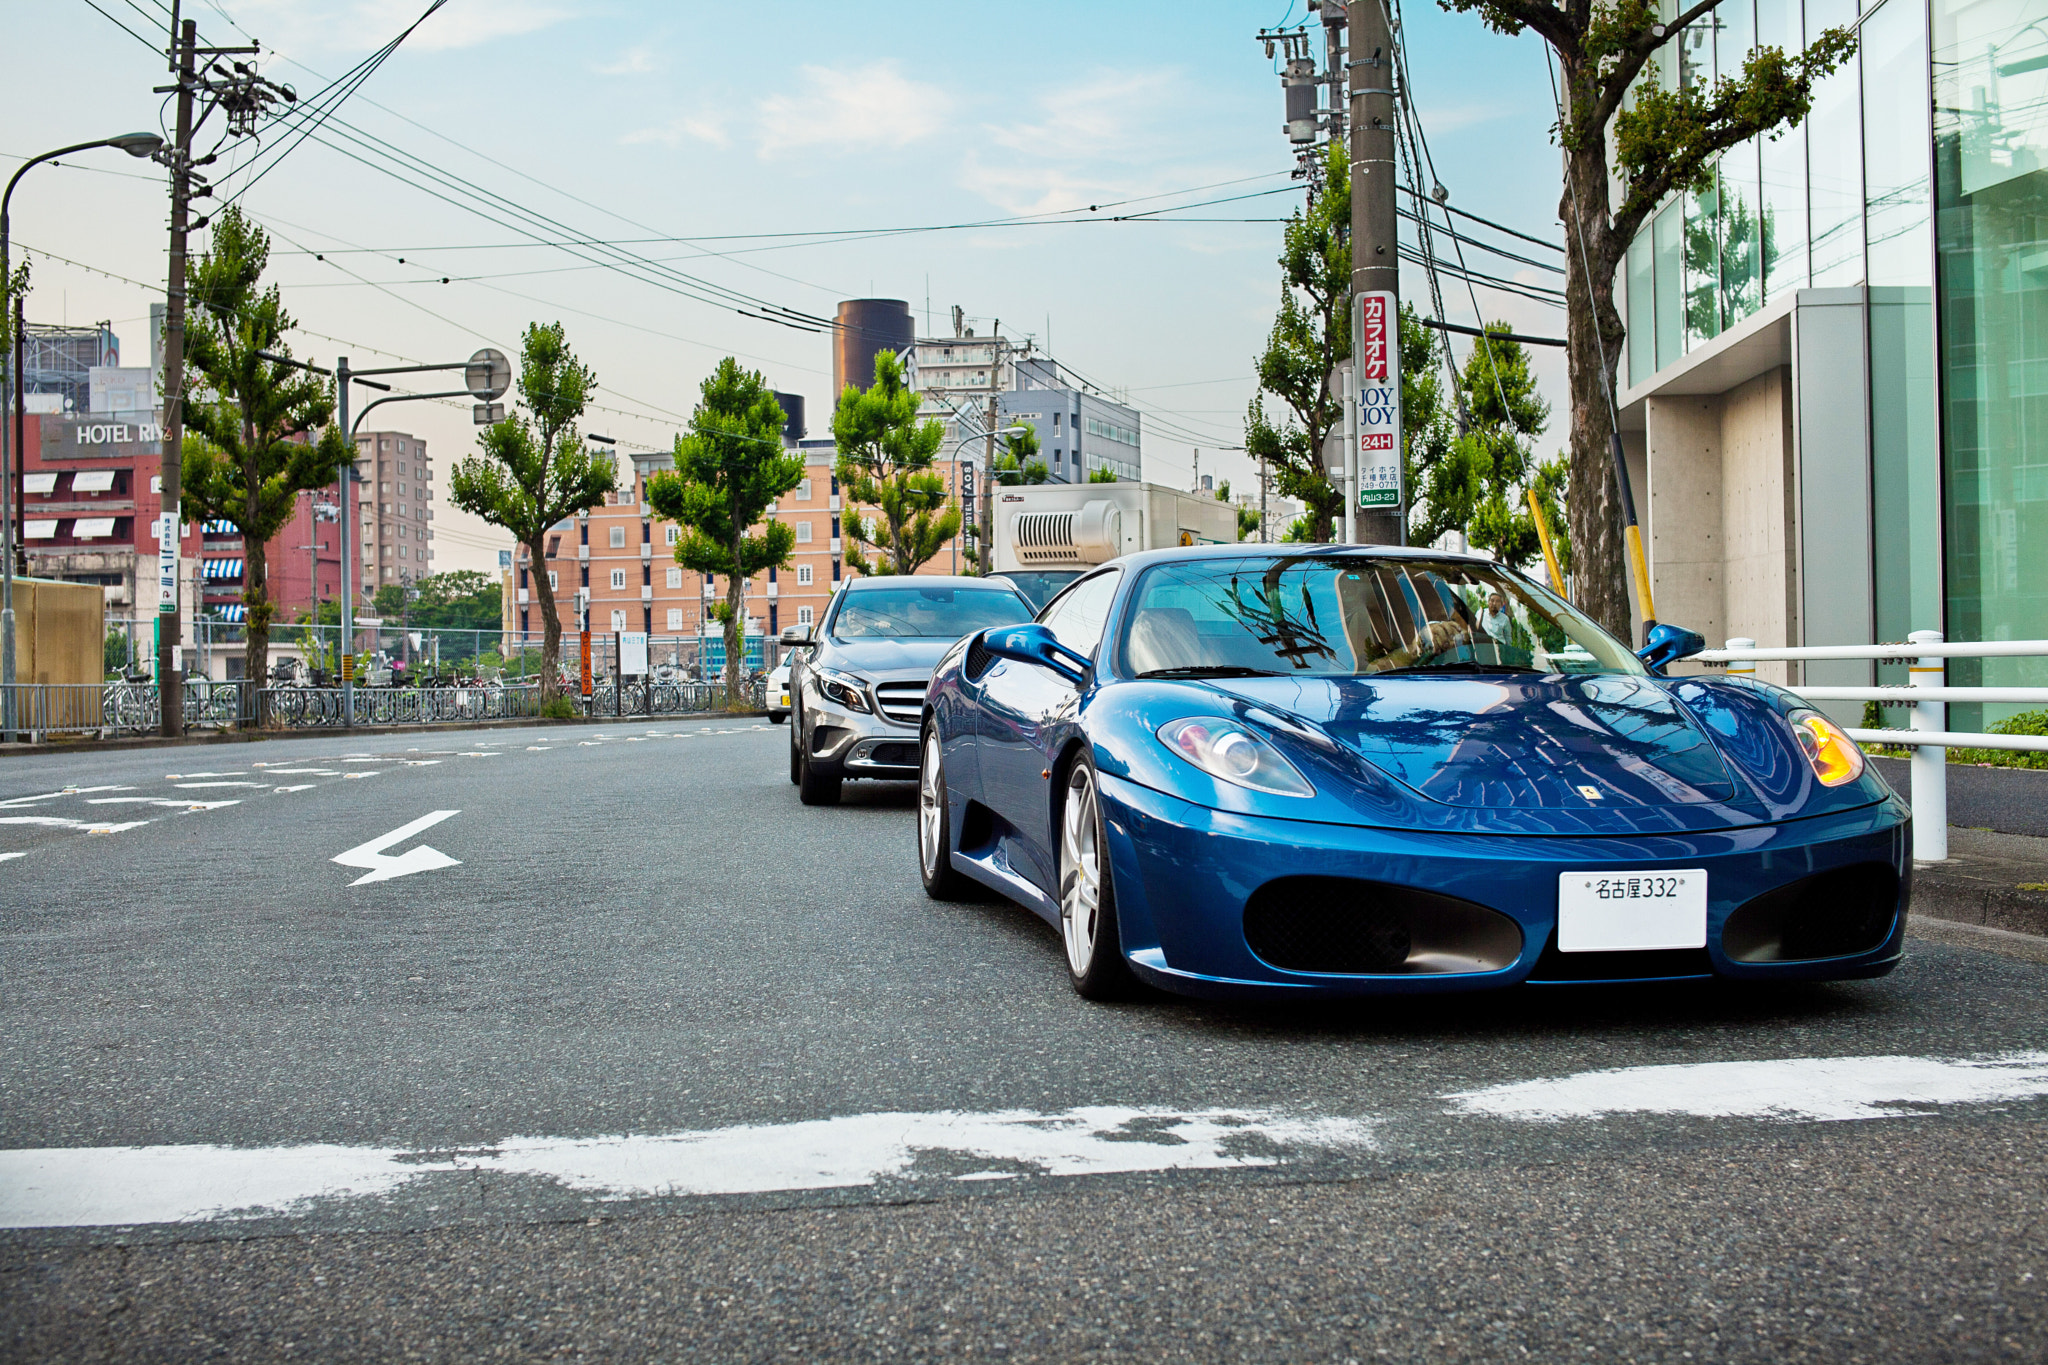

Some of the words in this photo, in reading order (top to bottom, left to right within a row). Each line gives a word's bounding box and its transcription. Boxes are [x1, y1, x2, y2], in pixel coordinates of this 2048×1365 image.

[1365, 298, 1385, 378] カラオケ
[1359, 387, 1394, 407] JOY
[1361, 407, 1396, 426] JOY
[77, 424, 133, 444] HOTEL
[1363, 435, 1391, 449] 24H
[964, 466, 972, 494] AOS
[1361, 481, 1398, 489] 249-0717
[1362, 493, 1395, 502] 内山3-23
[965, 502, 973, 526] HOTEL
[1595, 877, 1677, 899] 名古屋332
